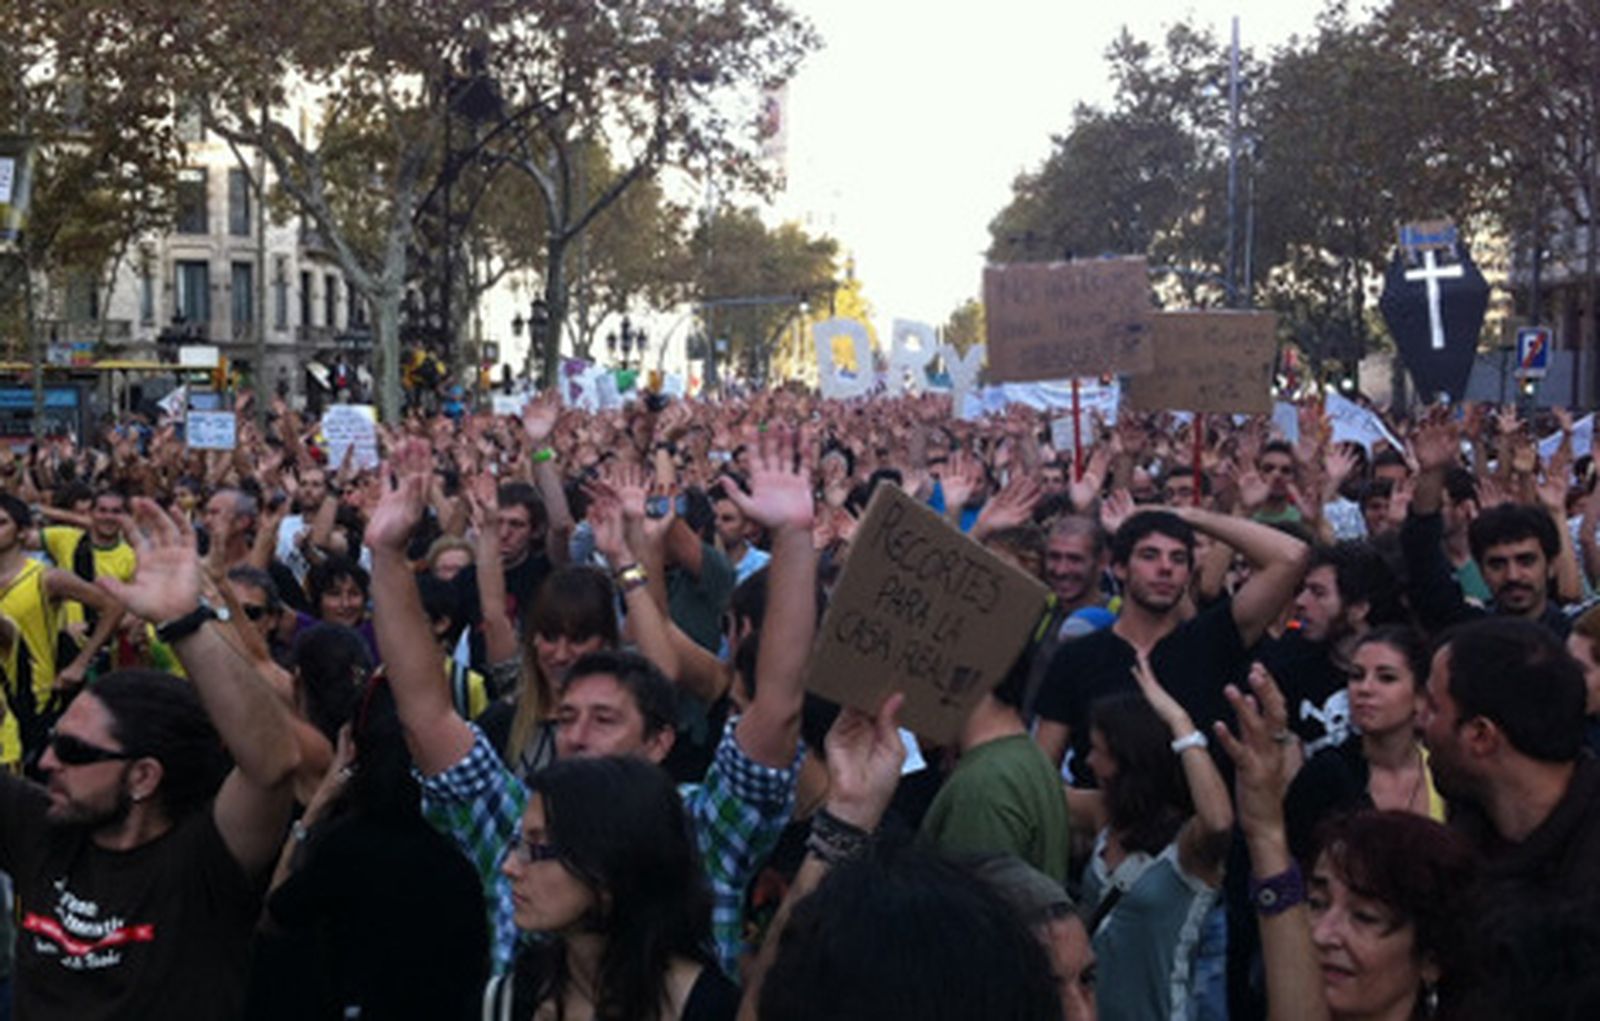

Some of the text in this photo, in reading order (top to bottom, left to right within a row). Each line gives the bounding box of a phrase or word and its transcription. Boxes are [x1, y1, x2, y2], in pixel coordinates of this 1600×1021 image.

[835, 609, 892, 662] CASA
[874, 574, 965, 647] PARA LA
